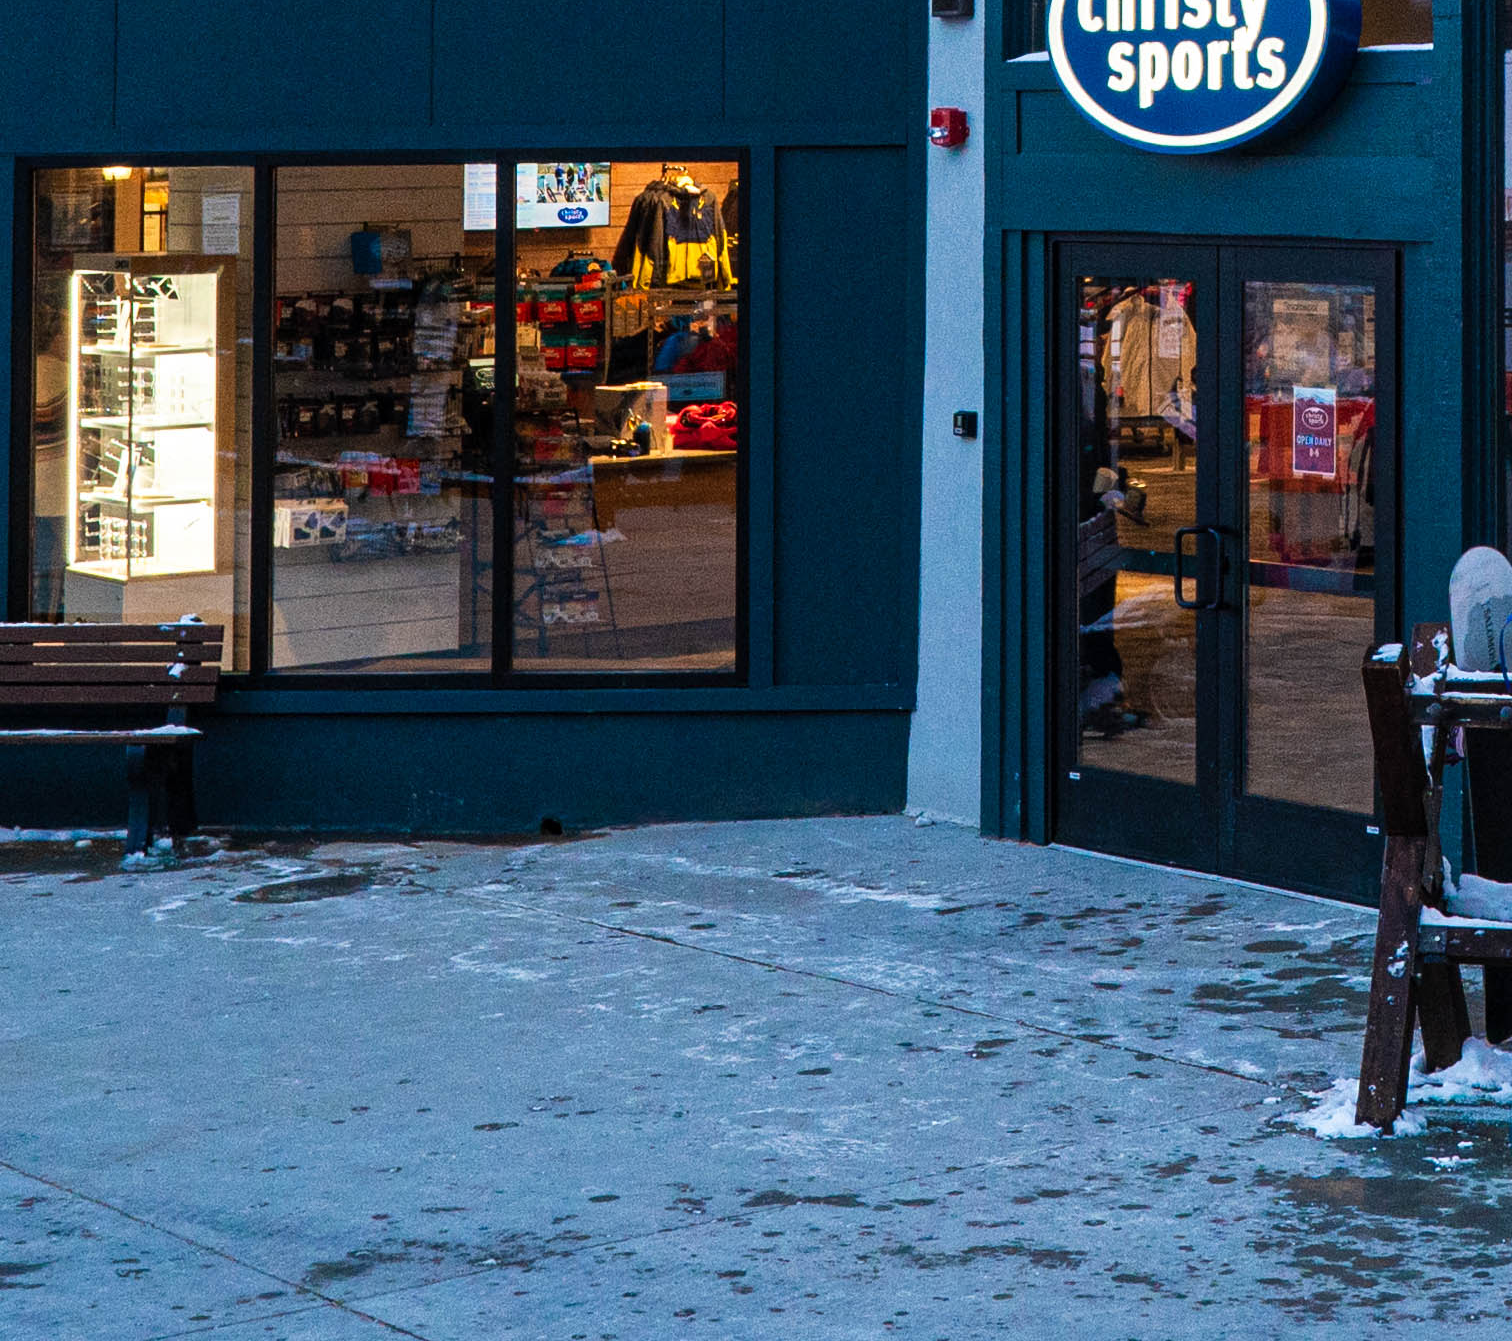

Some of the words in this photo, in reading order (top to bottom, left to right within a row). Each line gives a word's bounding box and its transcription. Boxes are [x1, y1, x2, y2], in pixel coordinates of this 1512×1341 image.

[1106, 28, 1288, 110] sports
[1296, 435, 1314, 446] OPEN
[1314, 436, 1332, 447] DAILY
